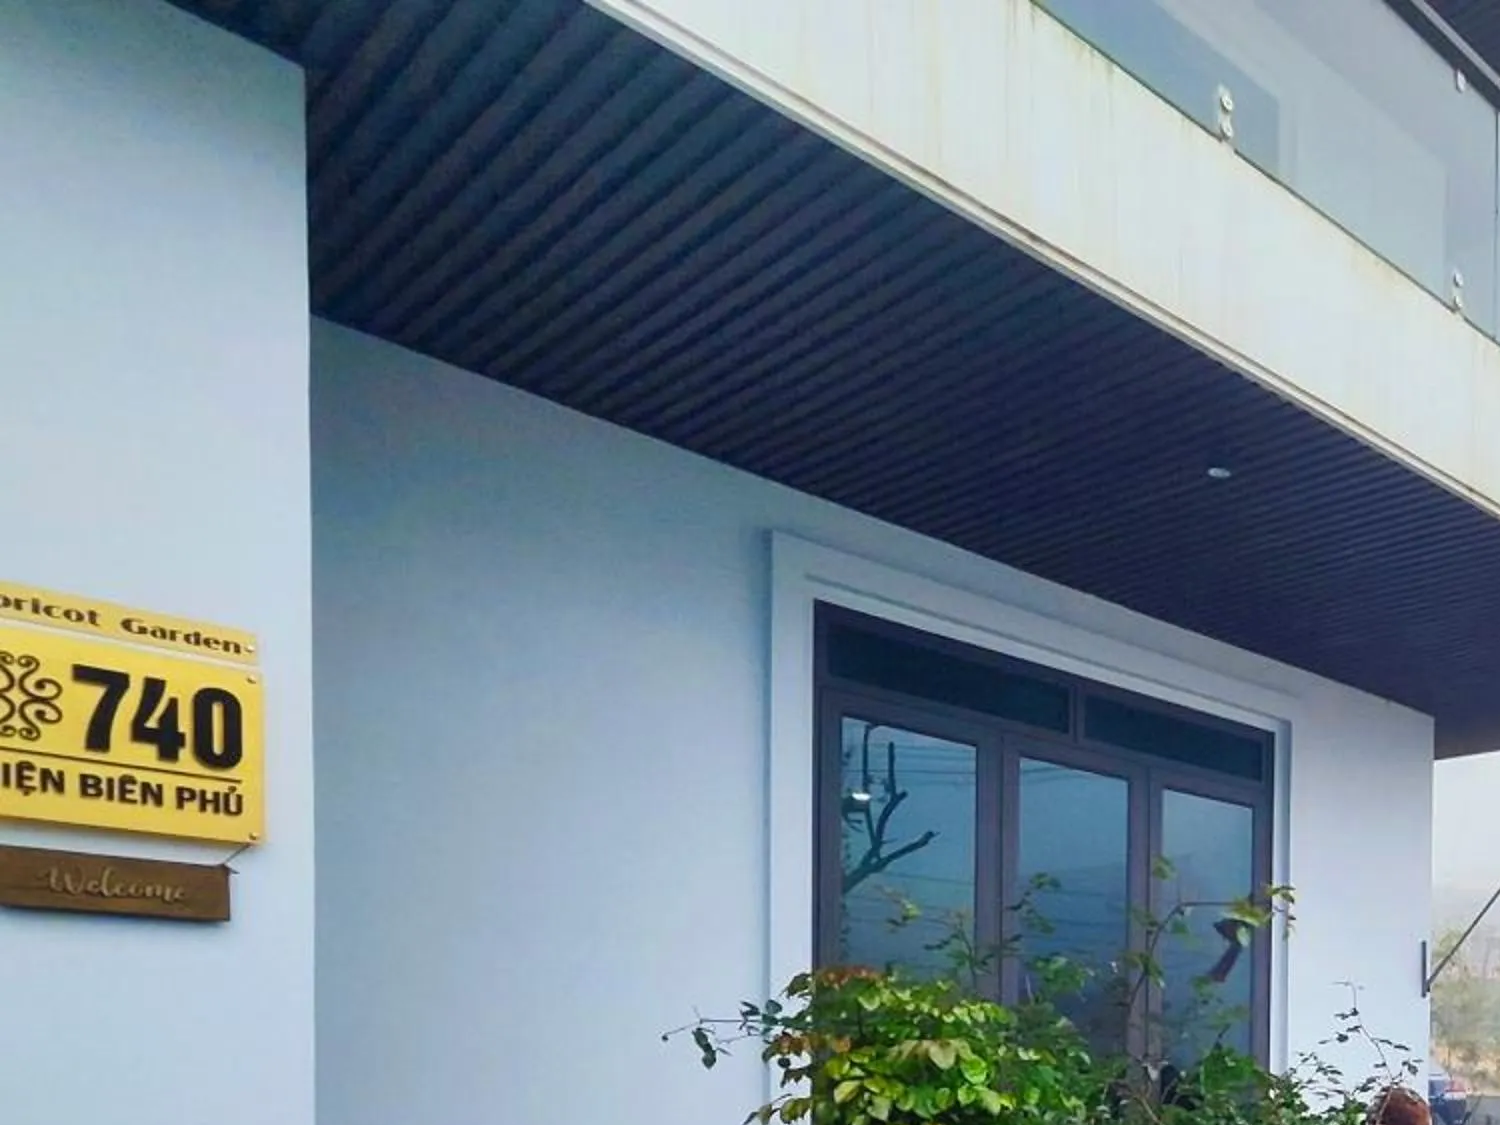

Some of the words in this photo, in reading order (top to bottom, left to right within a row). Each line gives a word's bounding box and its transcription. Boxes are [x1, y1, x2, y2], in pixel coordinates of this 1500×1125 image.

[120, 616, 242, 655] Garden
[72, 663, 244, 770] 740
[1, 761, 65, 797] IỆN
[79, 773, 164, 808] BIÊN
[175, 785, 244, 816] PHỦ
[38, 861, 186, 902] Welcome
